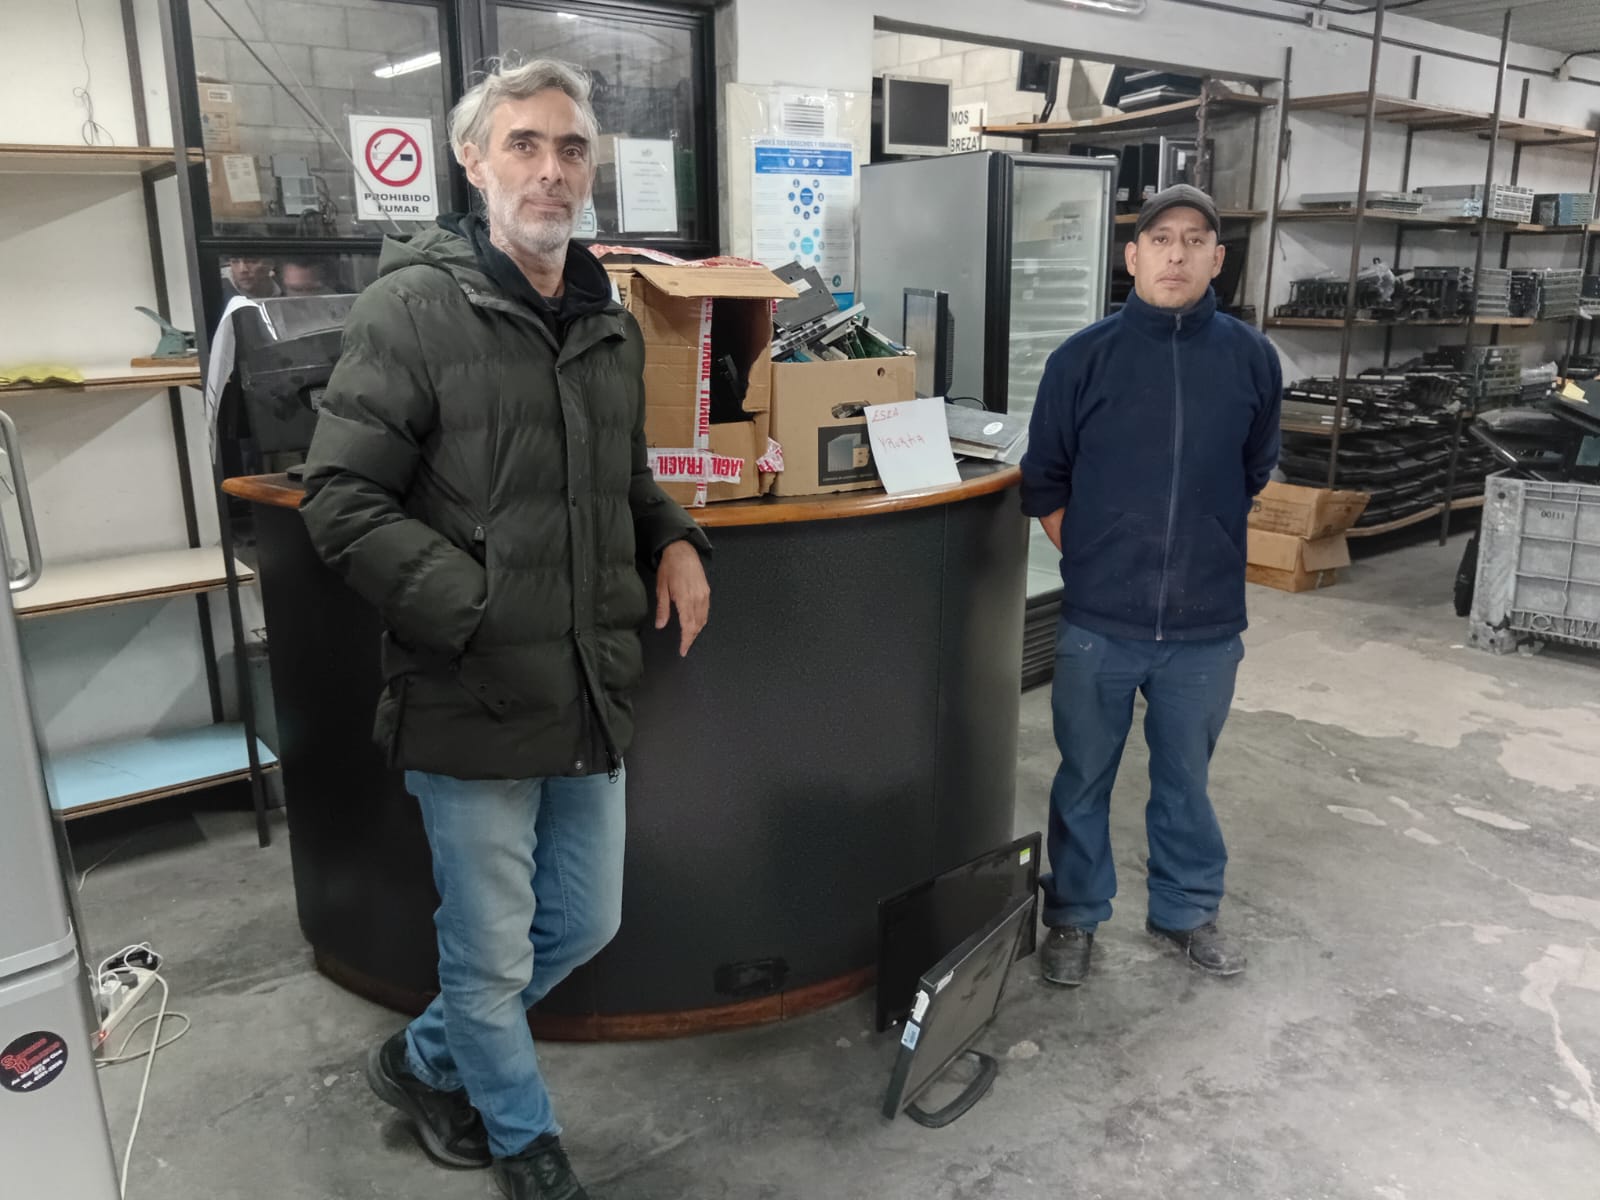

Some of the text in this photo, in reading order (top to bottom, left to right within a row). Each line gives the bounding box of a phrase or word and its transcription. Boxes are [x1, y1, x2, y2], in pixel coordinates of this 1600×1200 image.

[364, 192, 431, 202] PROHIBIDO
[377, 205, 420, 213] FUMAR
[657, 456, 703, 475] FRAGIL
